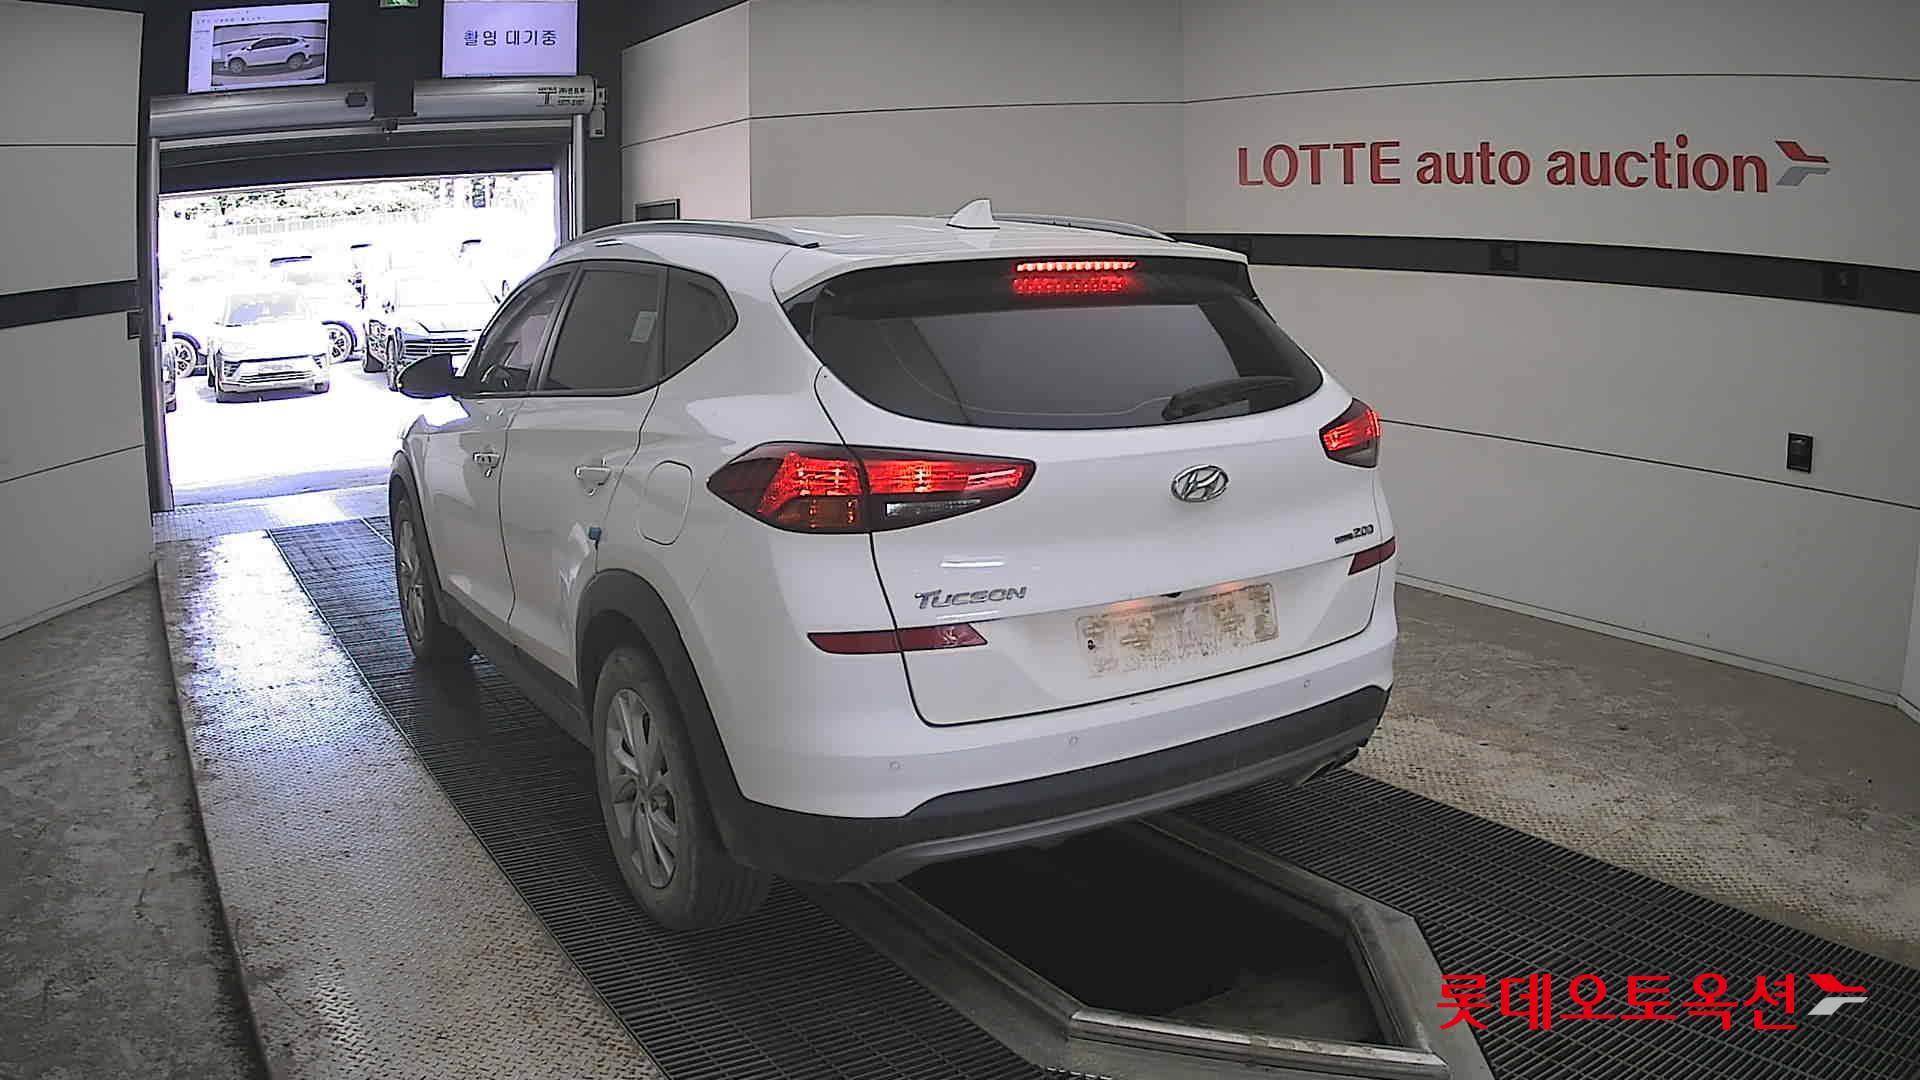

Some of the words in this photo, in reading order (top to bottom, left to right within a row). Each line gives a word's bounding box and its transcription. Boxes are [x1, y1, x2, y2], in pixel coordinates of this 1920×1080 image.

[505, 29, 558, 46] 대기중
[1237, 140, 1401, 187] LOTTE
[1416, 142, 1531, 186] auto
[1546, 134, 1769, 193] auction
[914, 586, 1027, 609] TUCSON
